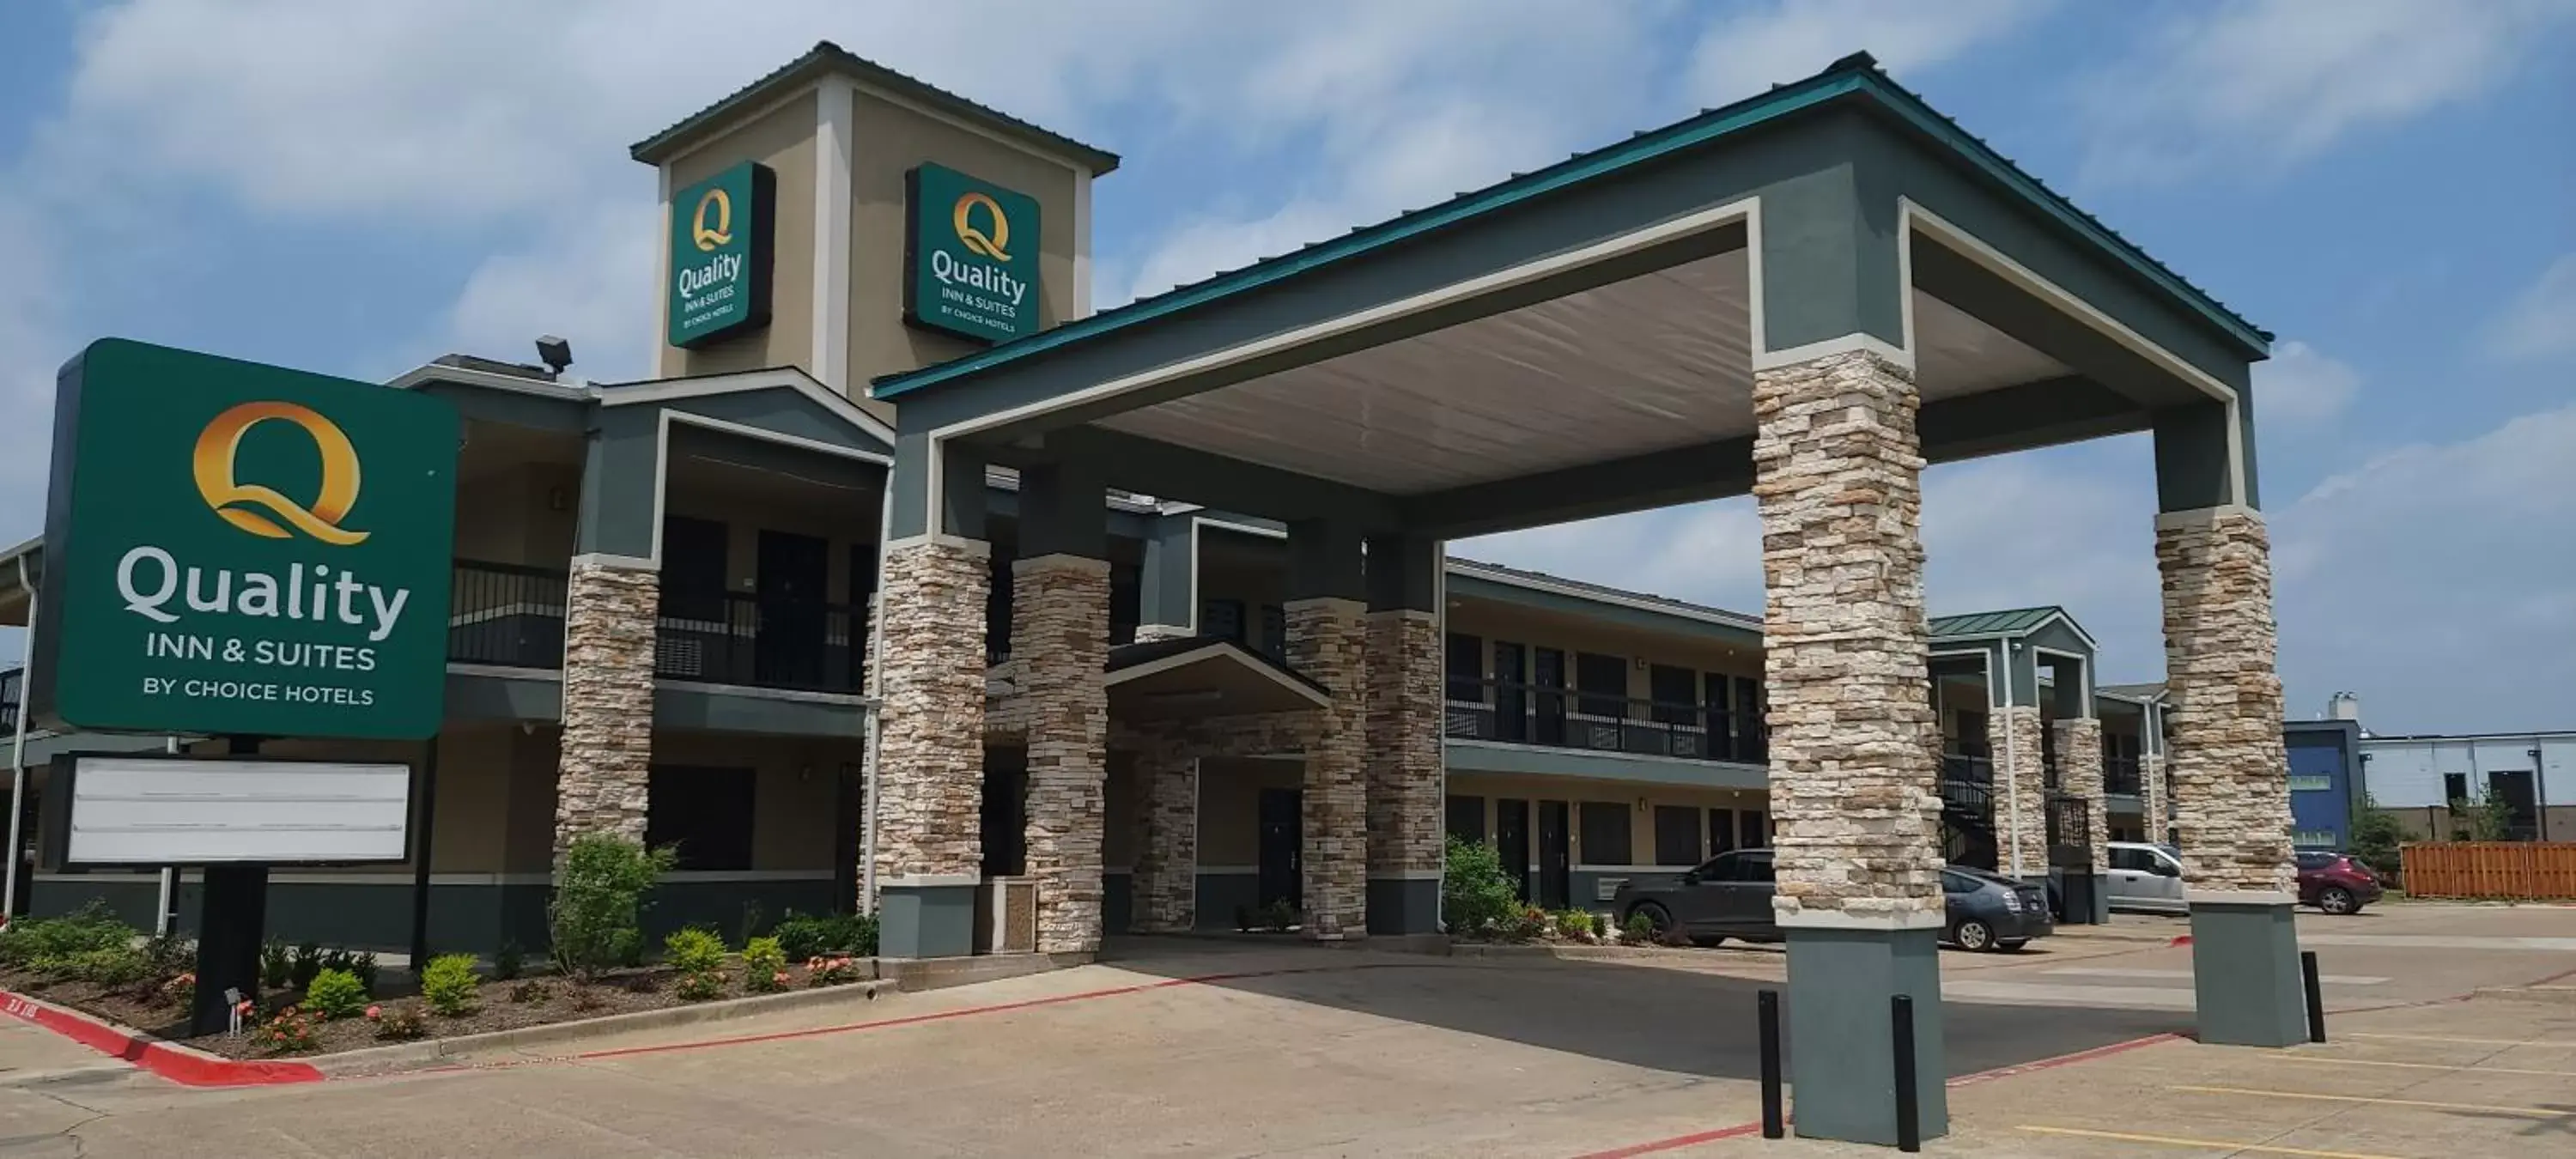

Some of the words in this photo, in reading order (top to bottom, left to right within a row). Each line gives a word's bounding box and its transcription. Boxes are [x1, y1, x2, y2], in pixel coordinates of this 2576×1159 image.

[693, 188, 732, 252] Q
[954, 191, 1012, 262] Q
[679, 253, 742, 298] Quality
[706, 284, 734, 305] SUITES
[932, 250, 1026, 305] Quality
[941, 305, 953, 314] BY
[954, 308, 983, 324] CHOICE
[986, 318, 1015, 333] HOTELS
[942, 286, 963, 303] INN
[965, 294, 974, 306] &
[975, 296, 1016, 319] SUITES
[193, 400, 370, 545] Q
[117, 545, 410, 641] Quality
[146, 632, 214, 660] INN
[222, 638, 246, 663] &
[254, 640, 376, 671] SUITES
[143, 677, 177, 695] BY
[185, 679, 277, 701] CHOICE
[286, 686, 374, 706] HOTELS
